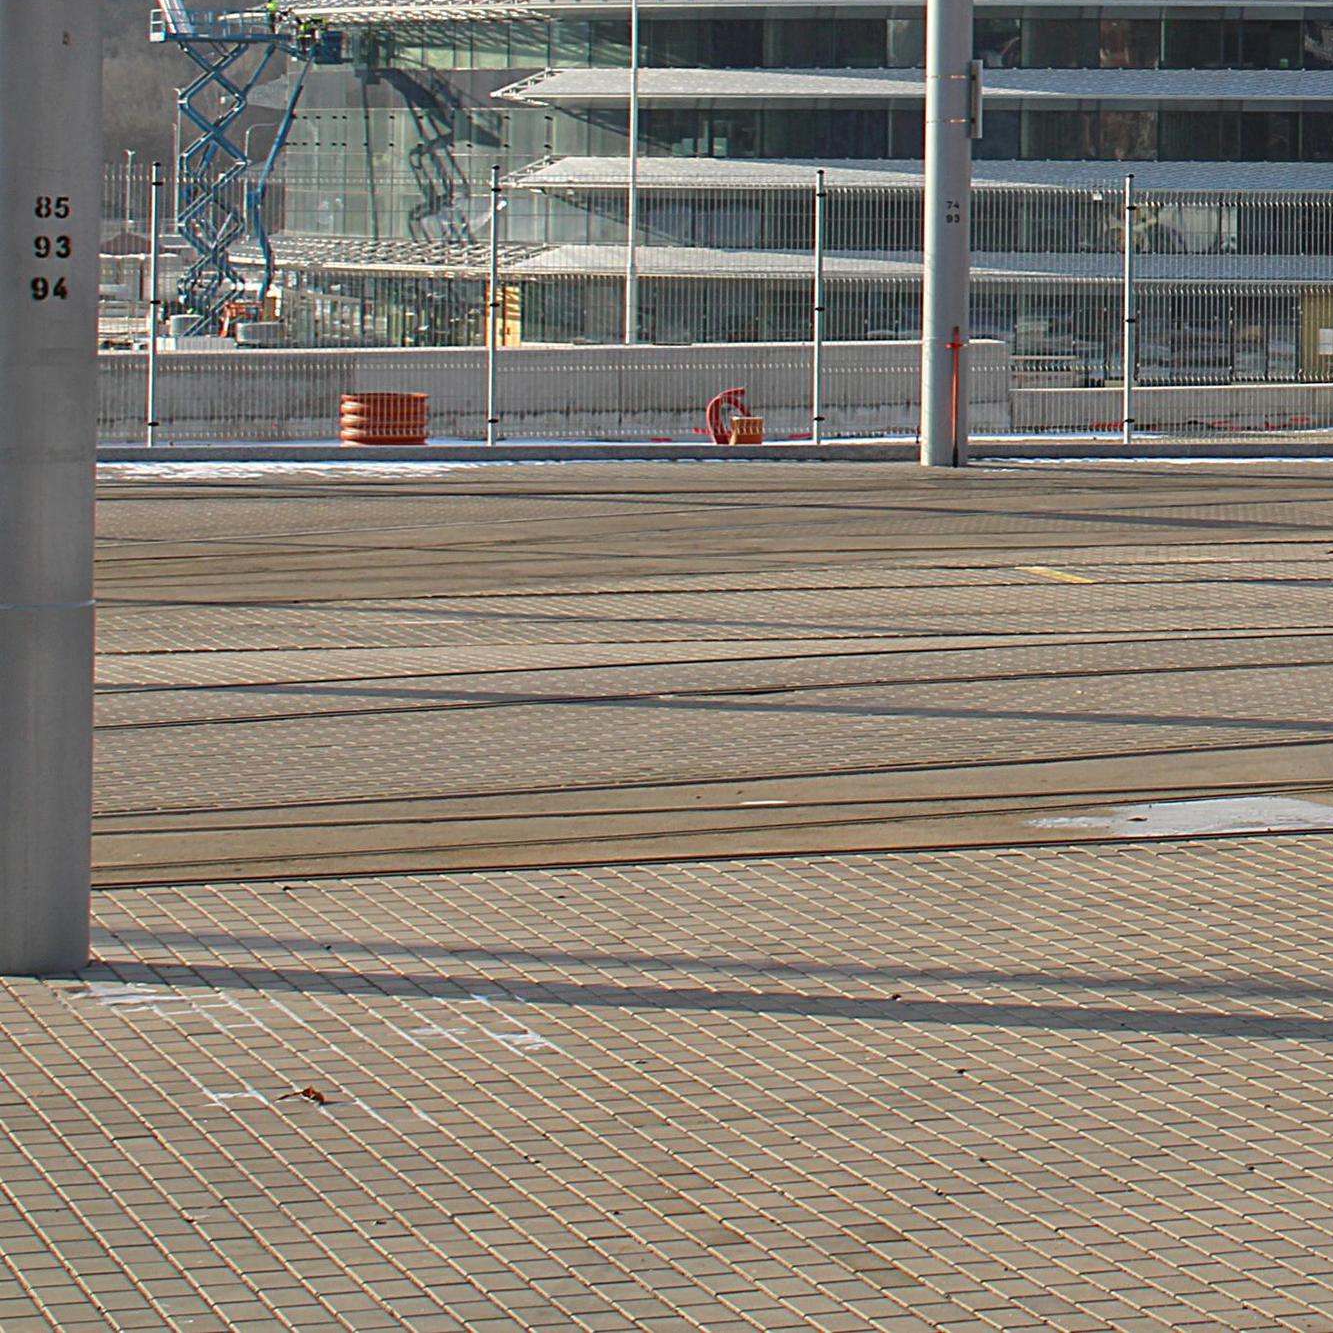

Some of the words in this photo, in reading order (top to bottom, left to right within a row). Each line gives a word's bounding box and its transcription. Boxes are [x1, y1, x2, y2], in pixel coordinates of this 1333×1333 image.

[34, 196, 69, 219] 85
[945, 200, 960, 209] 74
[945, 214, 960, 223] 93
[34, 235, 71, 259] 93
[31, 276, 68, 301] 94
